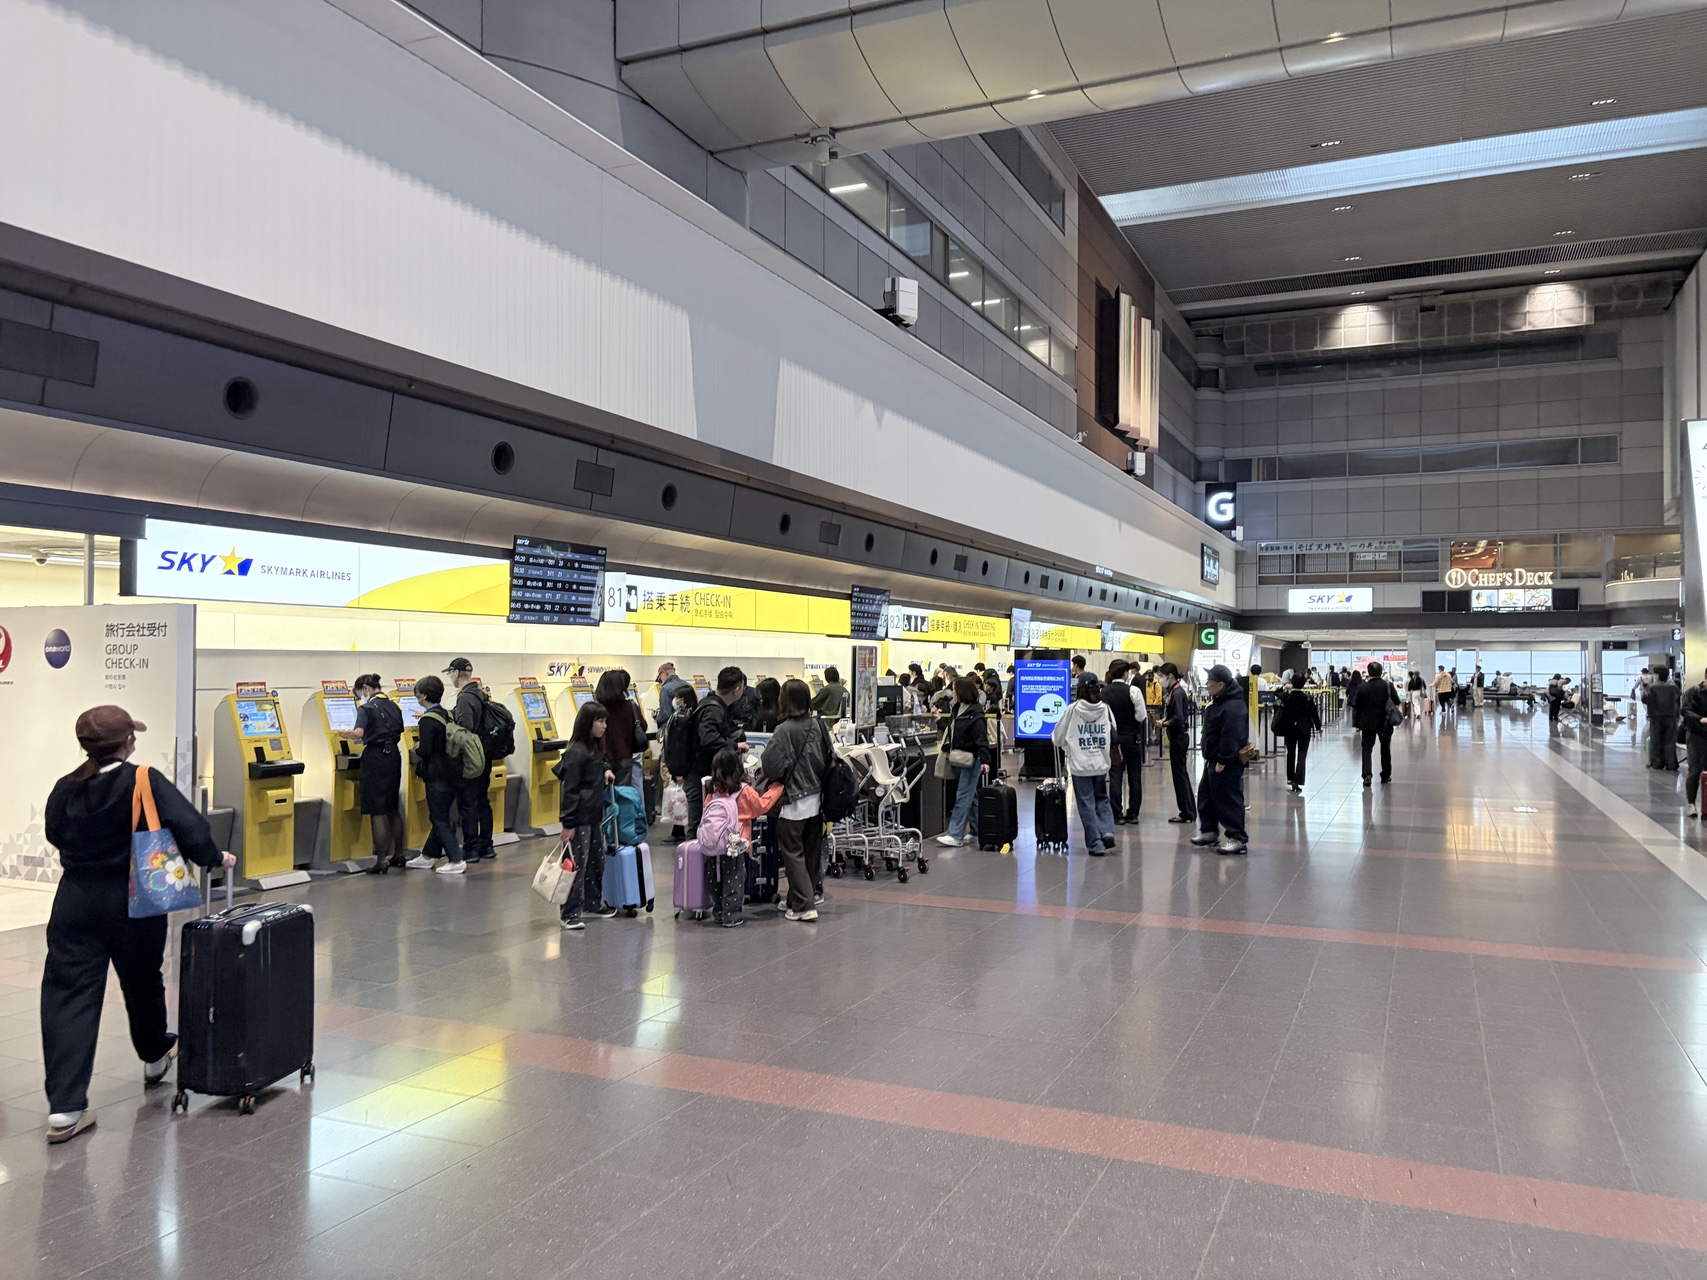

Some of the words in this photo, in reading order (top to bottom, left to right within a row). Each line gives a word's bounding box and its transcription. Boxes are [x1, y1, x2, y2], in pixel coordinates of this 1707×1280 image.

[1208, 492, 1235, 522] G
[157, 550, 218, 573] SKY
[260, 565, 308, 578] SKYMARK
[310, 570, 351, 581] AIRLINES
[1468, 569, 1513, 586] CHEF'S
[1514, 568, 1553, 586] DECK
[608, 587, 622, 608] 81
[643, 590, 690, 613] 搭乗手続
[694, 592, 731, 608] CHECK-IN
[1307, 595, 1335, 604] SKY
[890, 615, 900, 628] 82
[105, 622, 168, 638] 旅行会社受付
[1201, 628, 1216, 645] G
[105, 644, 138, 655] GROUP
[1232, 649, 1241, 660] G
[105, 658, 149, 669] CHECK-IN
[548, 665, 570, 676] SKY
[1078, 724, 1106, 734] VALUE
[1079, 737, 1106, 746] REFB
